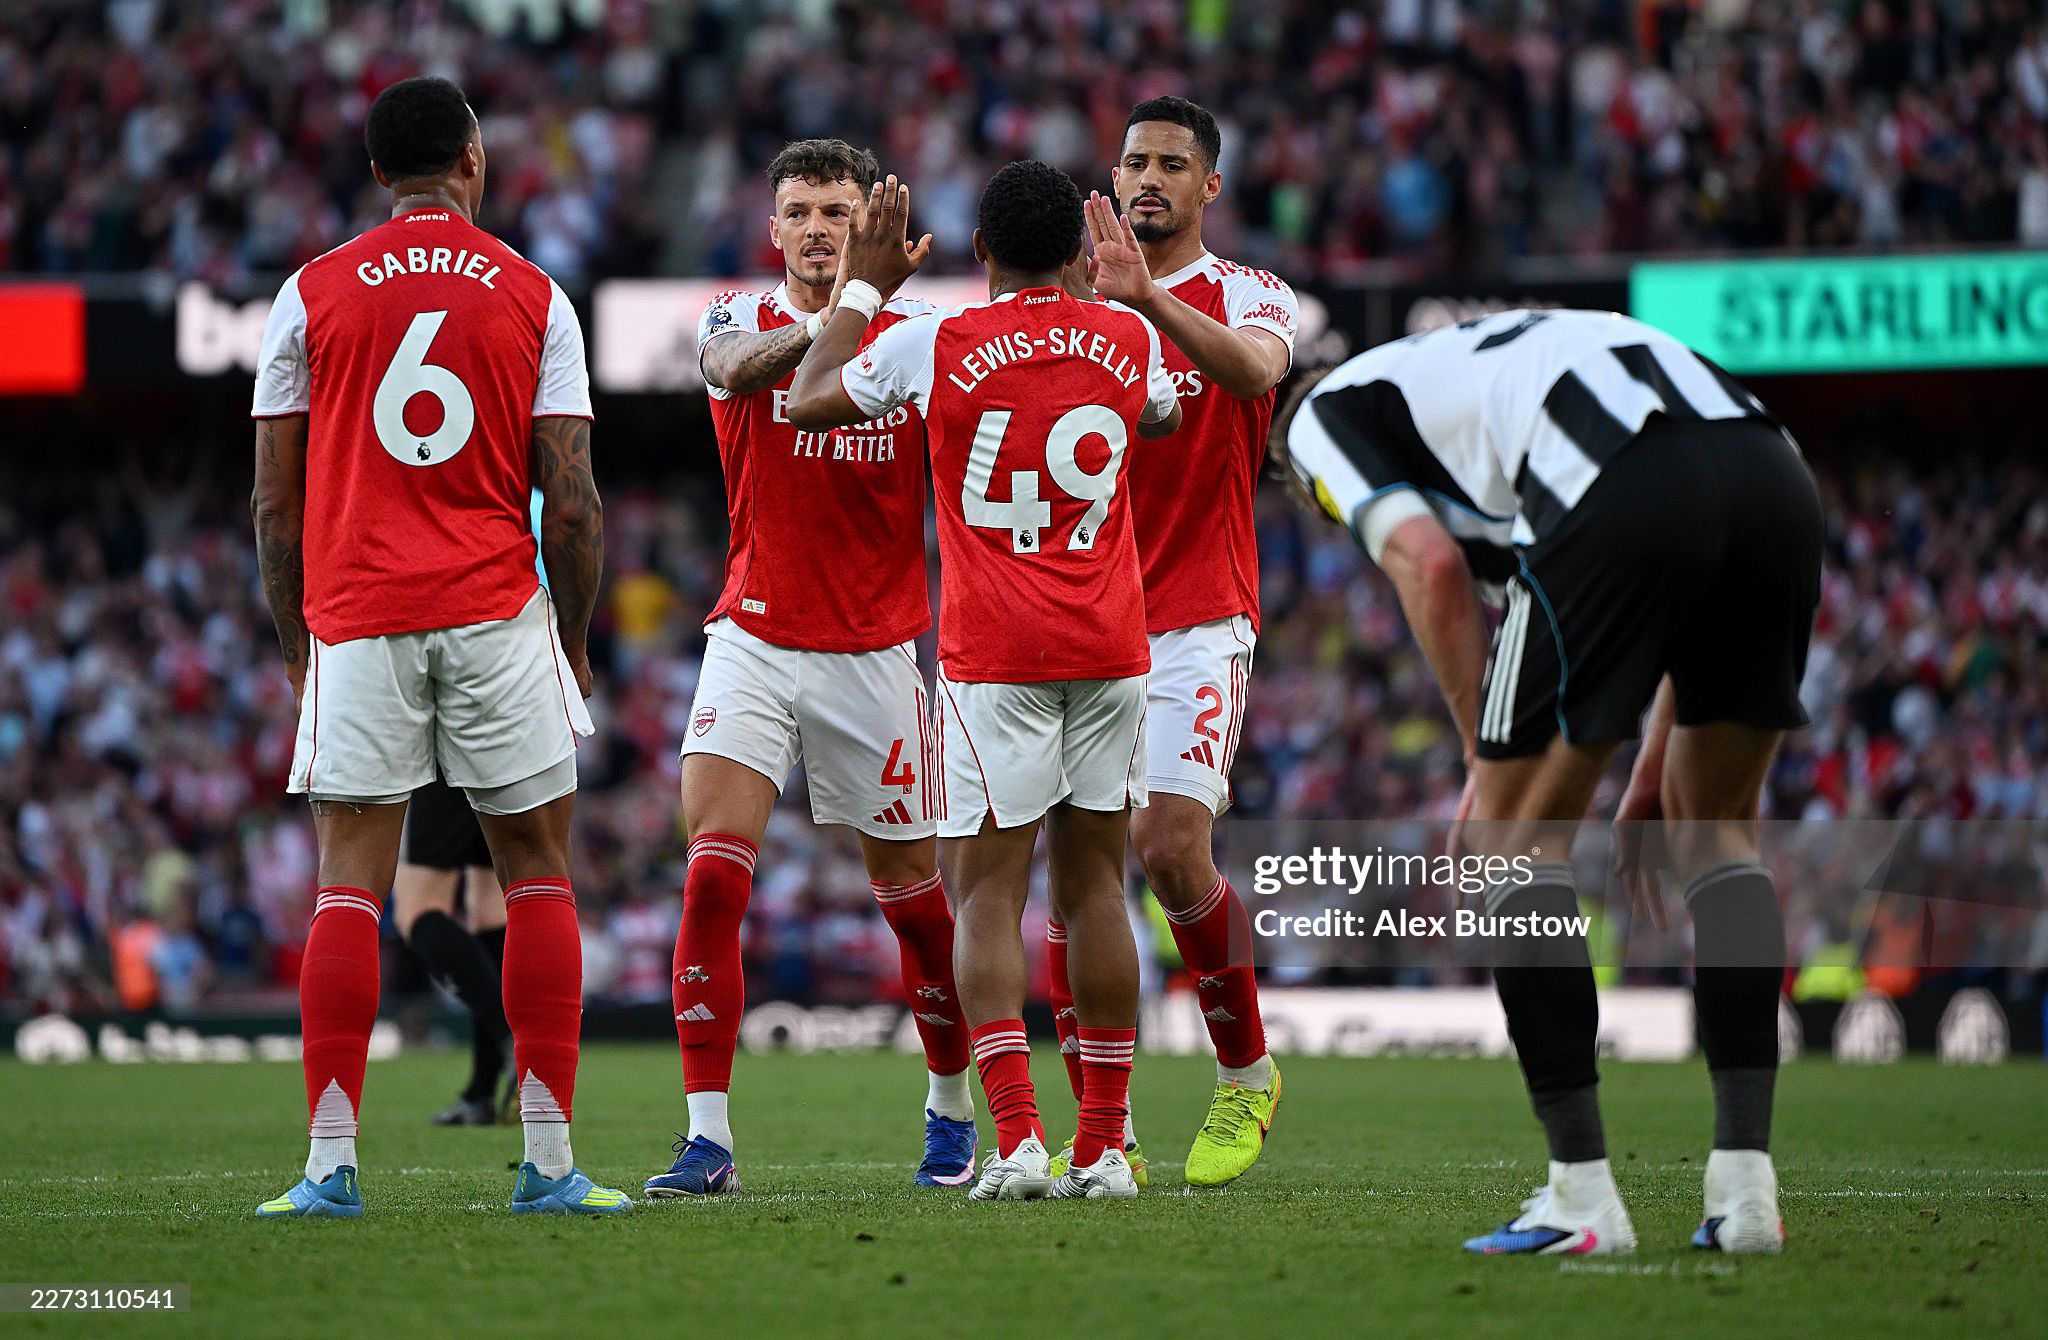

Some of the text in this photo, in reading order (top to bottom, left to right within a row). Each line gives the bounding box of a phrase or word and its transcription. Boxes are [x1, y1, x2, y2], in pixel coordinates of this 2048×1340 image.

[356, 247, 502, 290] GABRIEL
[1023, 291, 1061, 306] Arsenal
[372, 310, 475, 467] 6
[948, 327, 1141, 394] LEWIS-SKELLY
[793, 430, 895, 462] FLY BETTER
[961, 404, 1128, 554] 49
[1193, 685, 1223, 743] 2
[880, 738, 916, 795] 4
